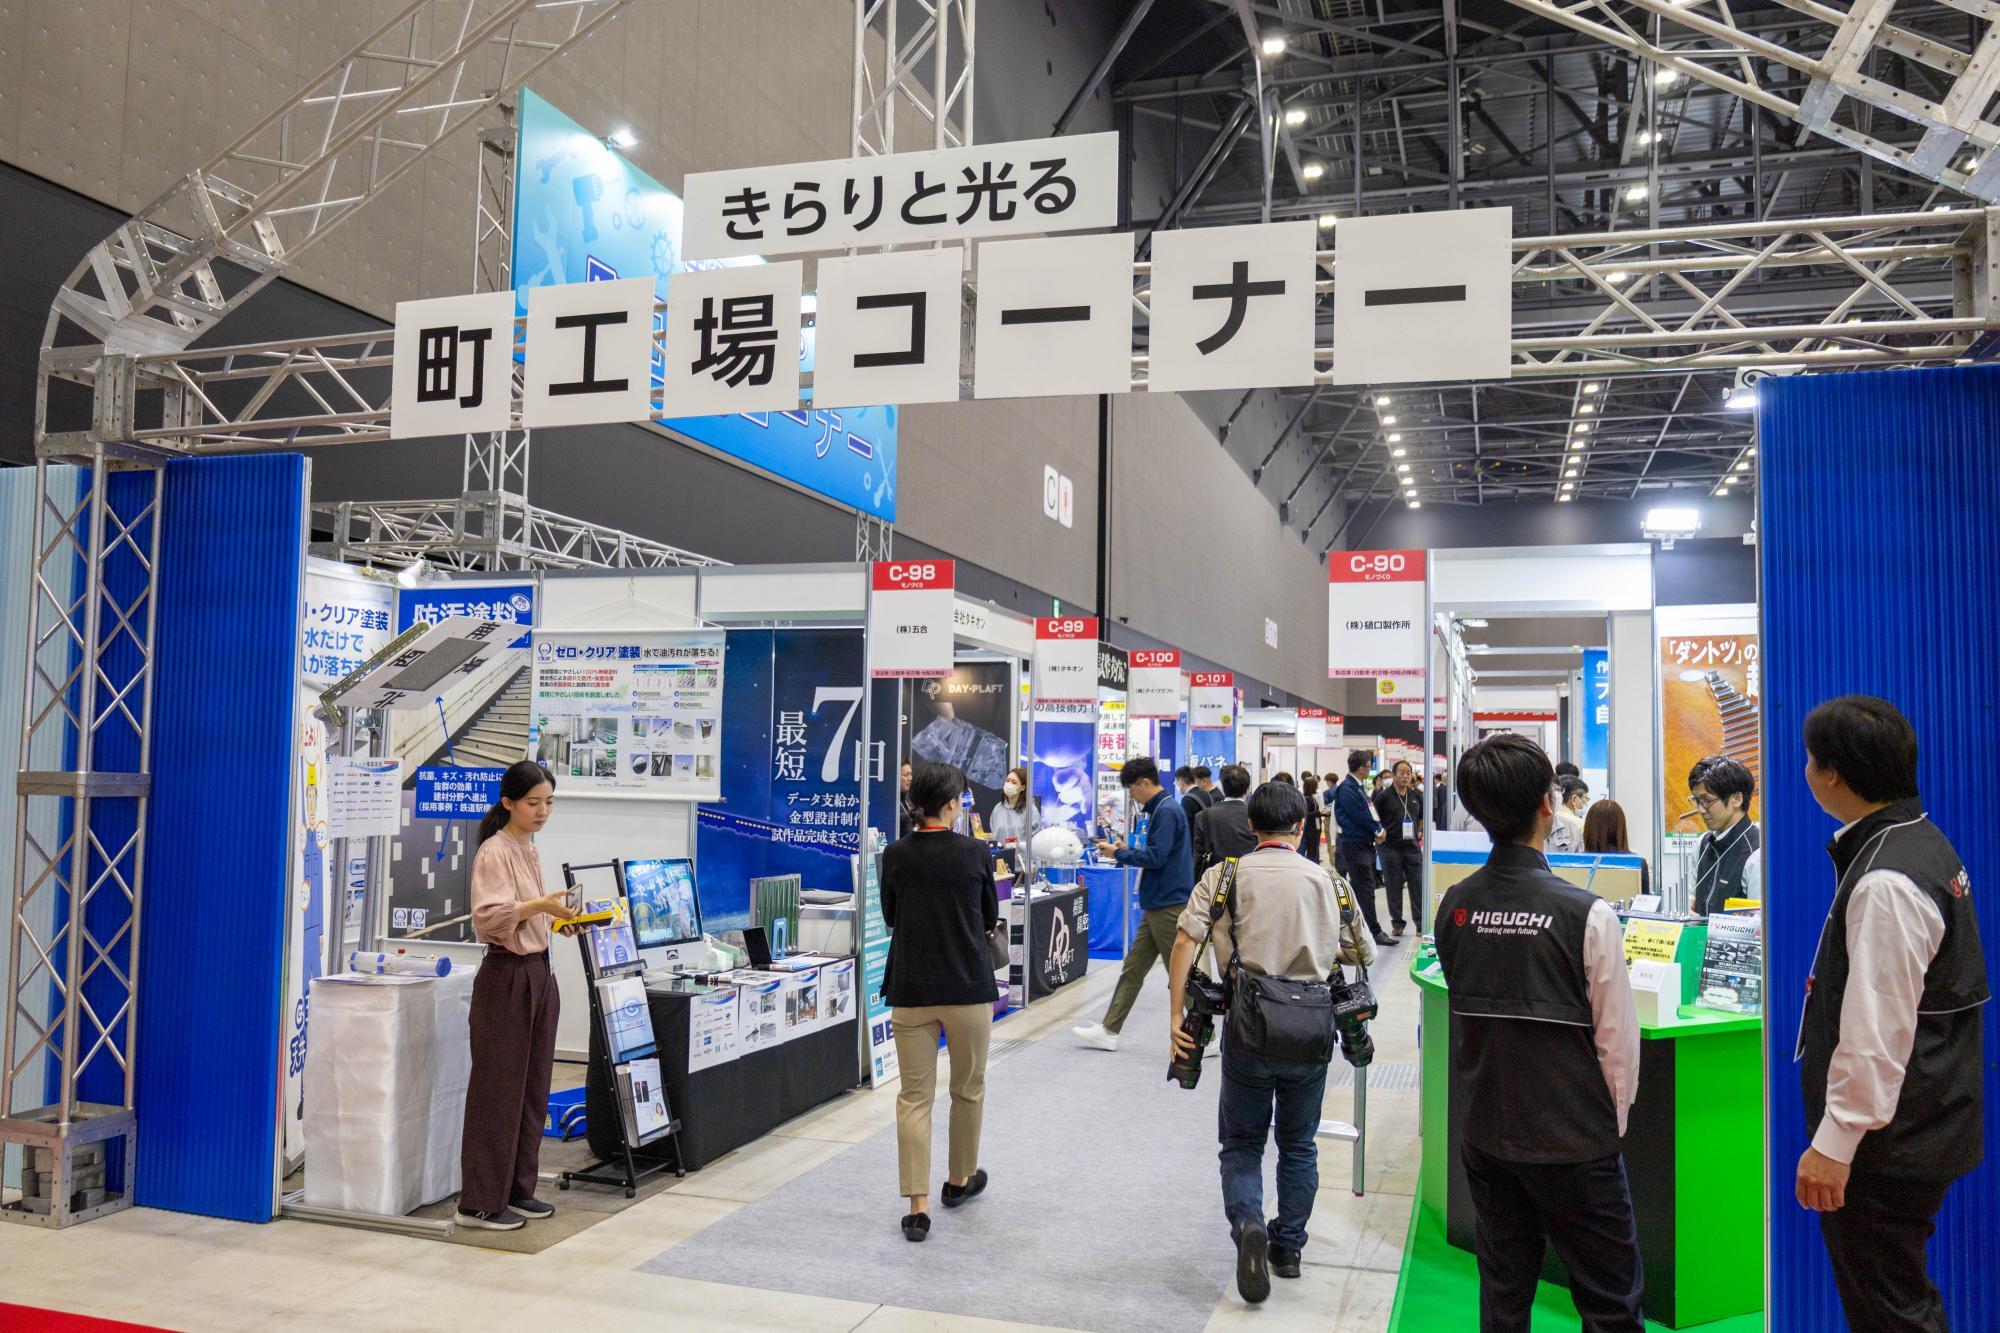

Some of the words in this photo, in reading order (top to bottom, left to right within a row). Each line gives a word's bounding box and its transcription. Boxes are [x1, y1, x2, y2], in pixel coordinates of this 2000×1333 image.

[721, 157, 1077, 241] きらりと光る
[417, 260, 1467, 409] 町工場コーナー
[1350, 555, 1405, 572] C-90
[889, 564, 936, 581] C-98
[896, 625, 928, 634] （株）五合
[1048, 620, 1084, 632] C-99
[1345, 620, 1411, 630] （株）樋口製作所
[304, 627, 364, 653] 水だけで
[1136, 652, 1174, 662] C-100
[1196, 674, 1226, 683] C-101
[433, 781, 486, 792] 抜群の効果！！
[771, 828, 860, 844] 試作品完成までの
[1470, 911, 1553, 929] HIGUCHI
[1477, 926, 1502, 935] Drawing
[1517, 927, 1538, 936] future
[1721, 924, 1755, 934] HIGUCHI
